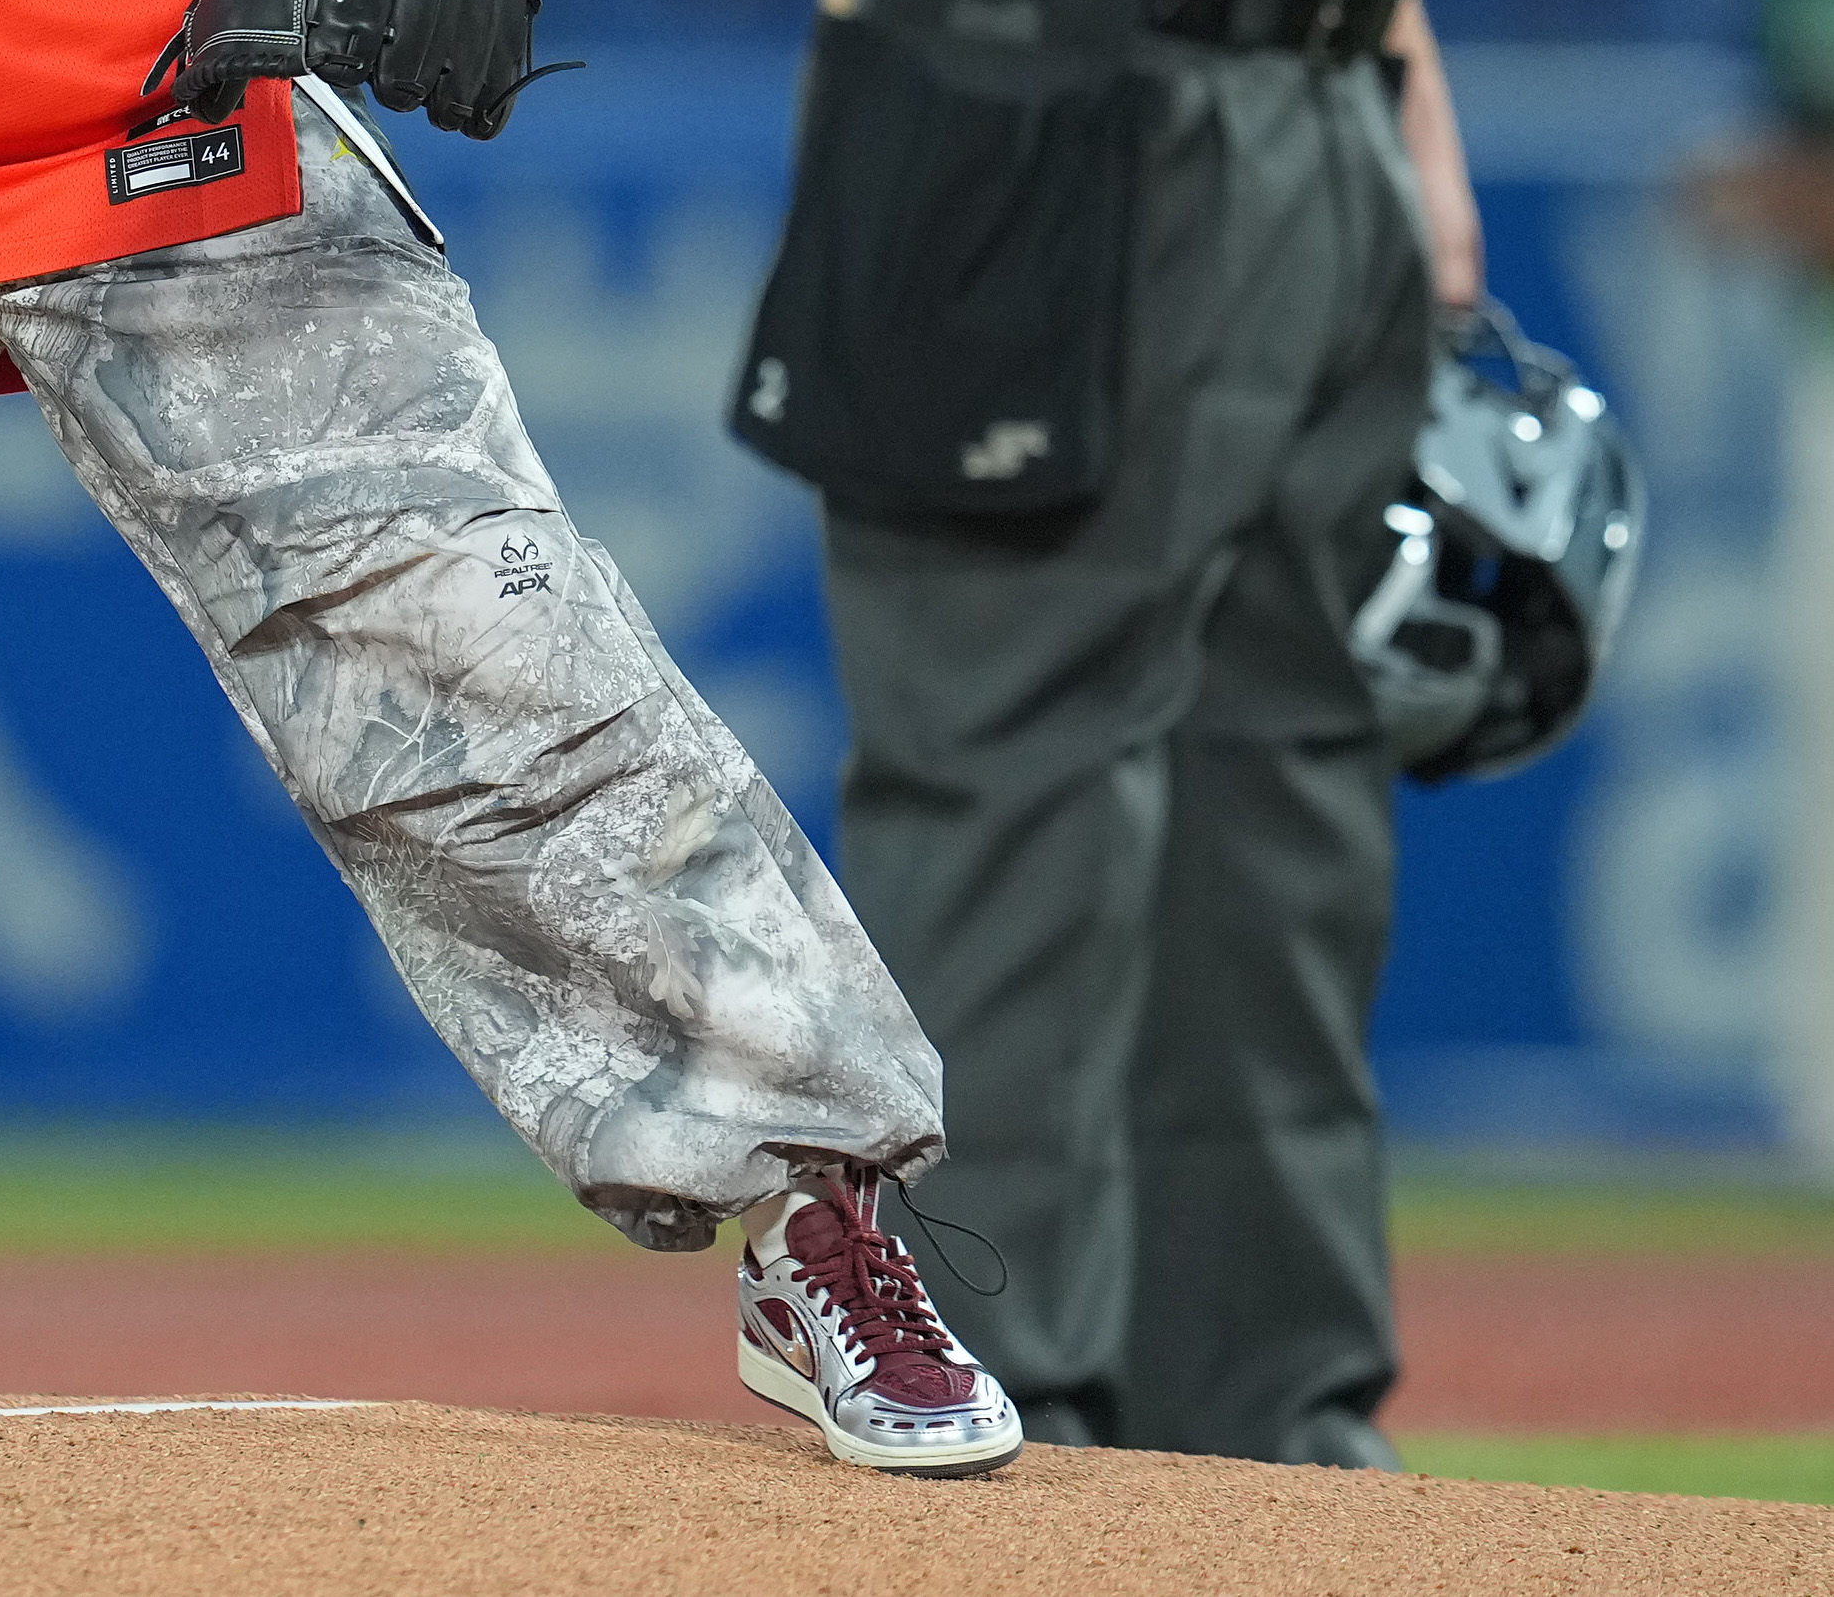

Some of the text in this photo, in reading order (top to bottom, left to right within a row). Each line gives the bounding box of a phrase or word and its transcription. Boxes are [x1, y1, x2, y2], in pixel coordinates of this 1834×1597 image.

[126, 141, 188, 159] QUALITY PERFORMANCE
[127, 153, 148, 164] PRODUCT
[148, 149, 171, 159] INSPIRED
[201, 142, 230, 165] 44
[127, 158, 153, 169] GREATEST
[153, 154, 174, 163] PLAYER
[109, 157, 119, 194] LIMITED
[498, 572, 554, 599] APX
